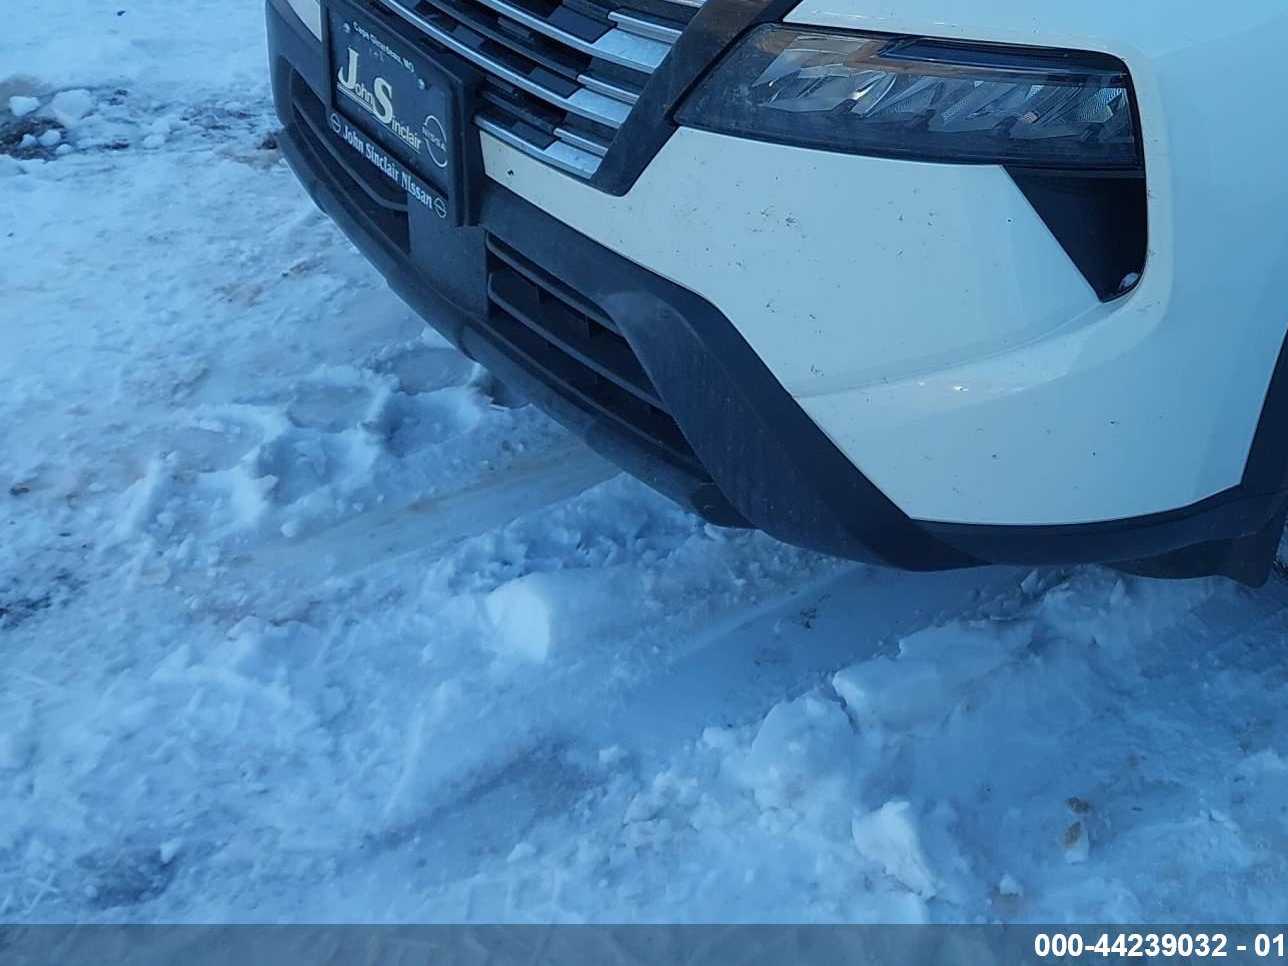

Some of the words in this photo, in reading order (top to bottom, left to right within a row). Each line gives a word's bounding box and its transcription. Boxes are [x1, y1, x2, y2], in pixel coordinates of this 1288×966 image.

[338, 47, 375, 105] John
[374, 77, 421, 150] Sinclair
[343, 125, 364, 153] John
[365, 142, 399, 182] Sinclair
[401, 171, 433, 209] Nissan
